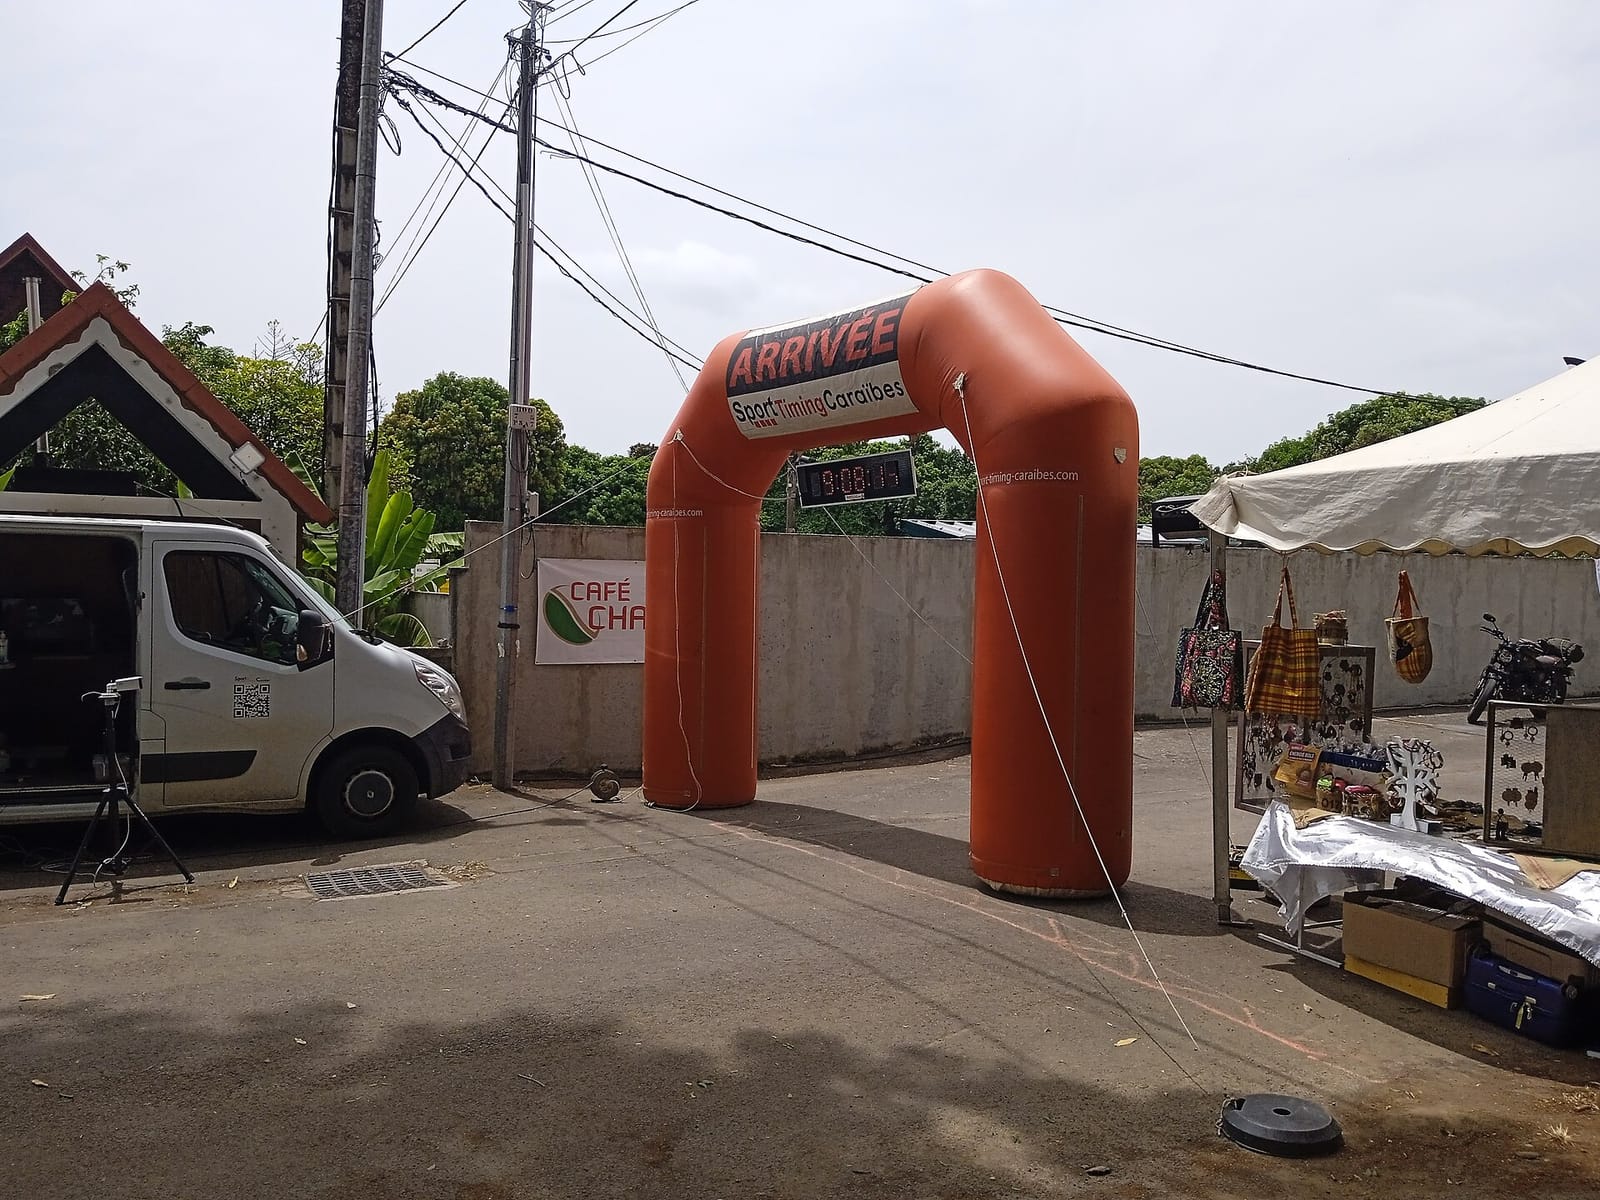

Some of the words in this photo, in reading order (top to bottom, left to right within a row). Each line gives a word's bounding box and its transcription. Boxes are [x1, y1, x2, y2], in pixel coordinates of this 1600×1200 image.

[729, 308, 900, 388] ARRIVÉE
[570, 577, 631, 602] CAFÉ
[588, 605, 646, 630] CHA
